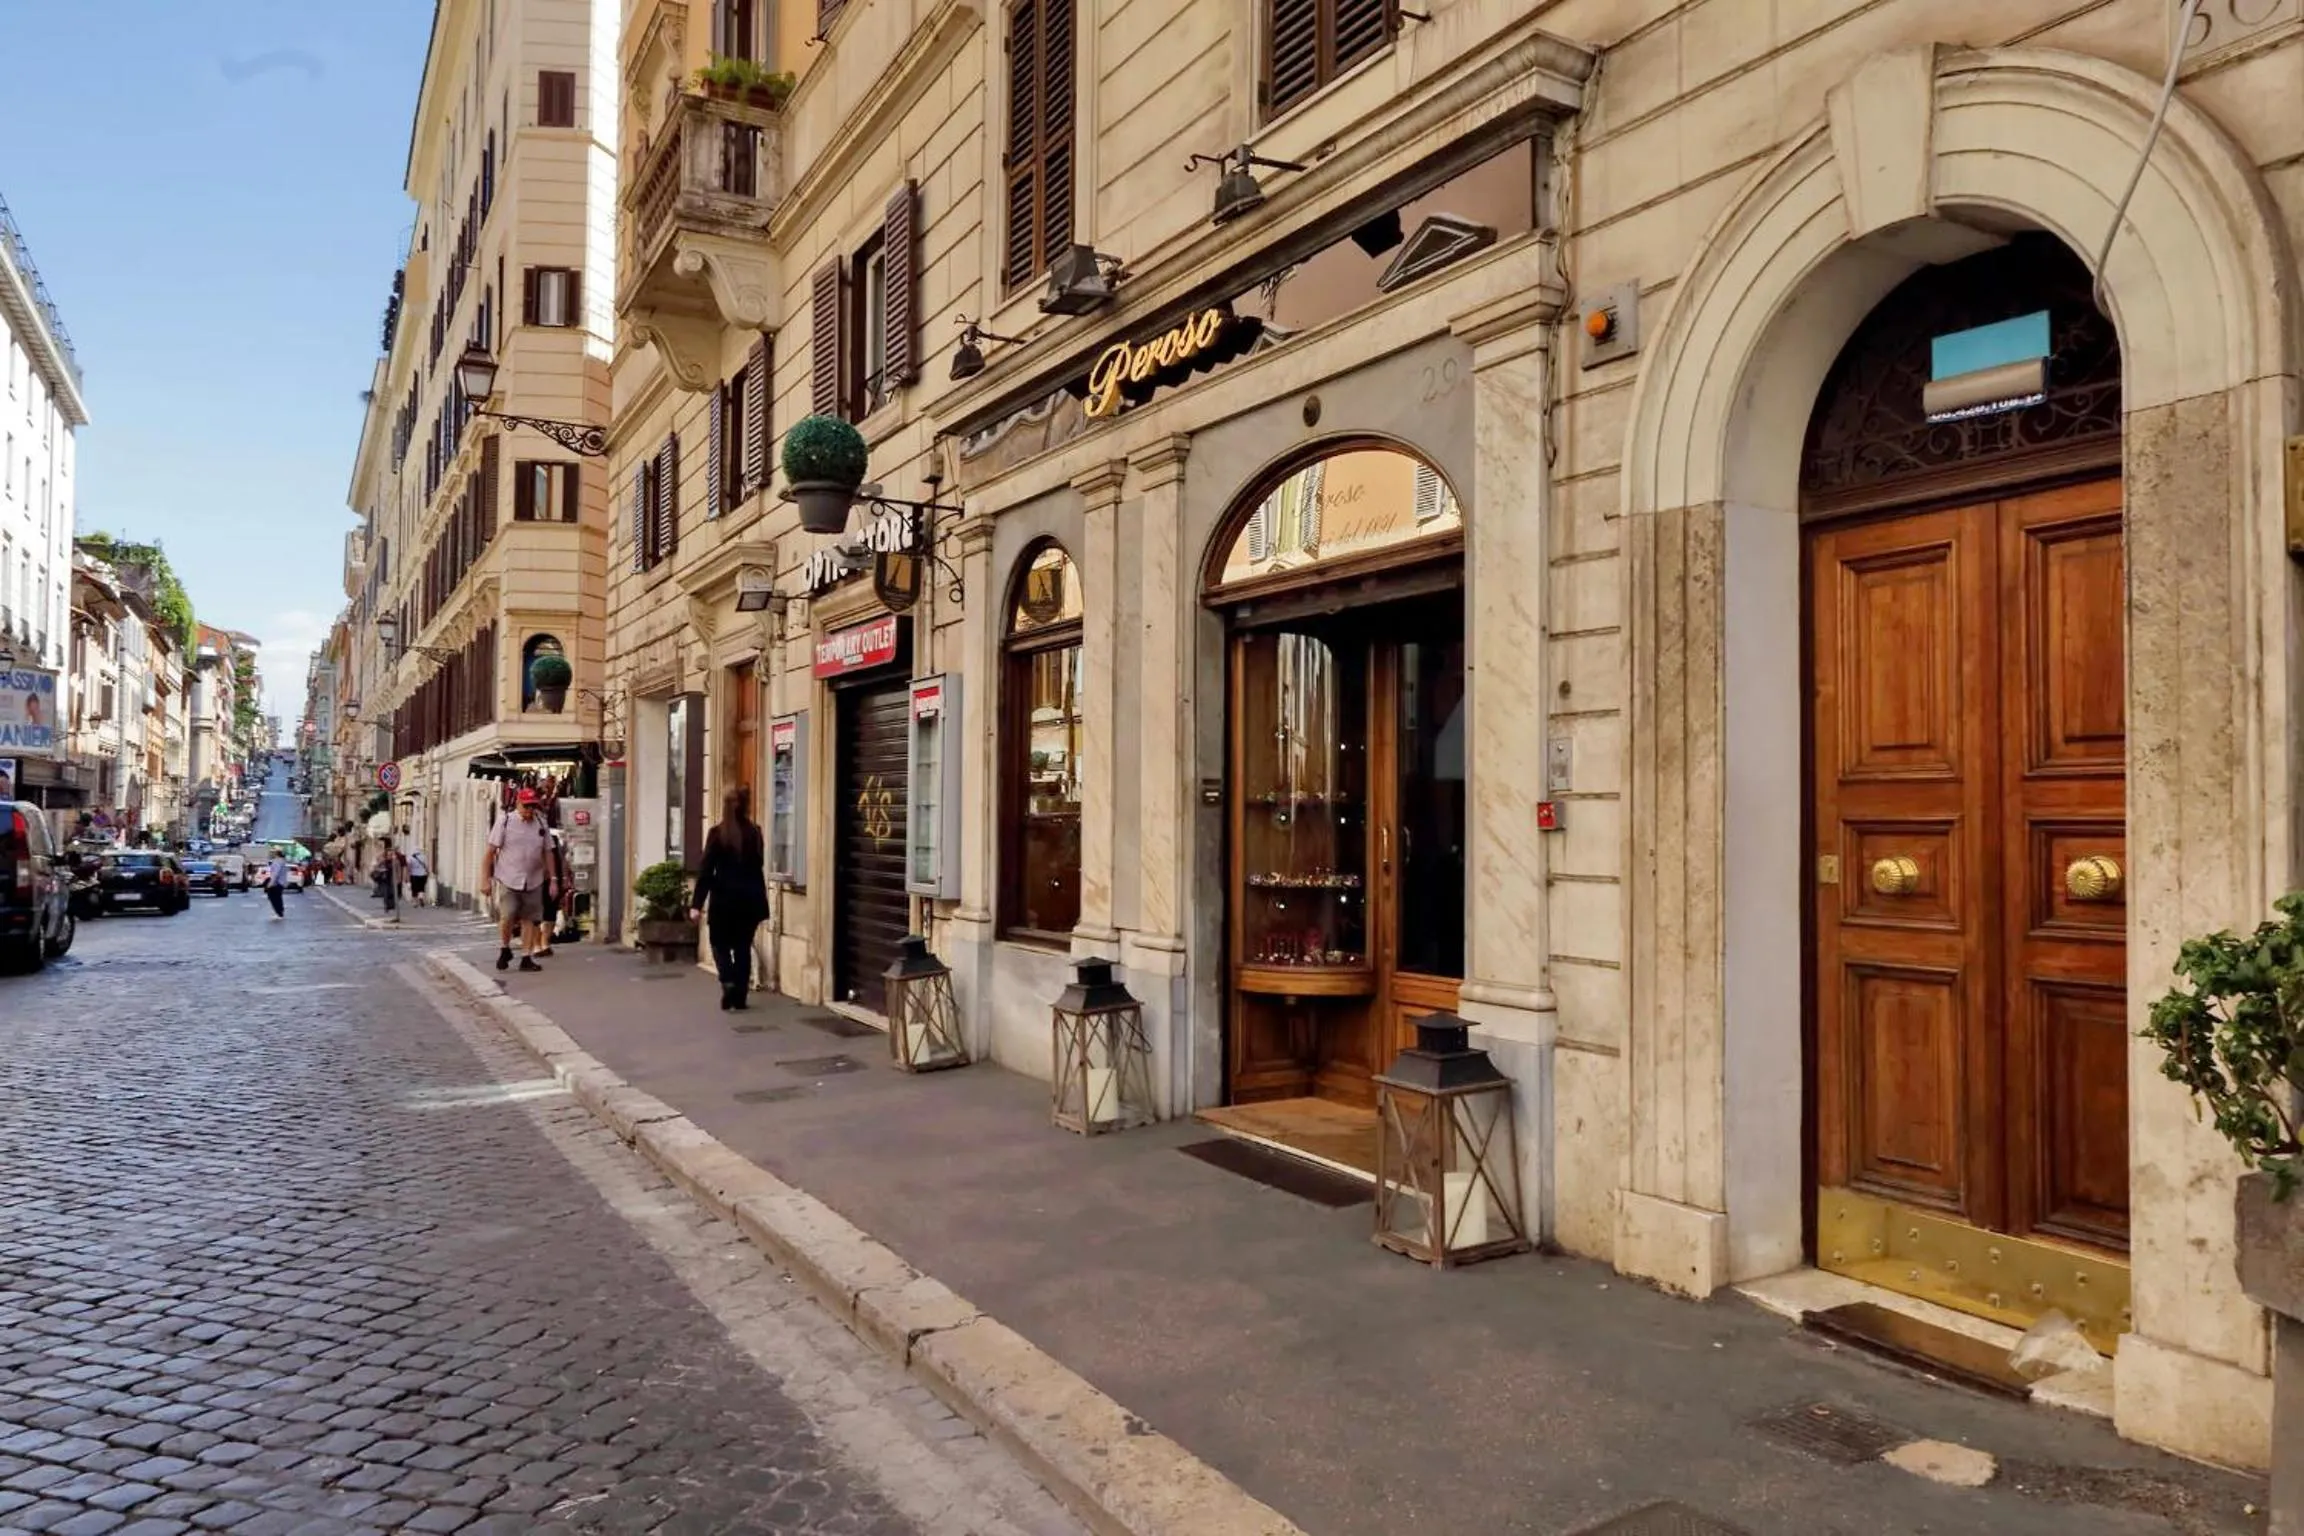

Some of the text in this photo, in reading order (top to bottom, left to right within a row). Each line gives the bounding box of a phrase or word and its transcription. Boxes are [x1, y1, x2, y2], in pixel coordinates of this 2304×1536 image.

[1084, 308, 1222, 417] Peroso
[801, 550, 849, 592] OPTI
[863, 621, 896, 654] OUTLET
